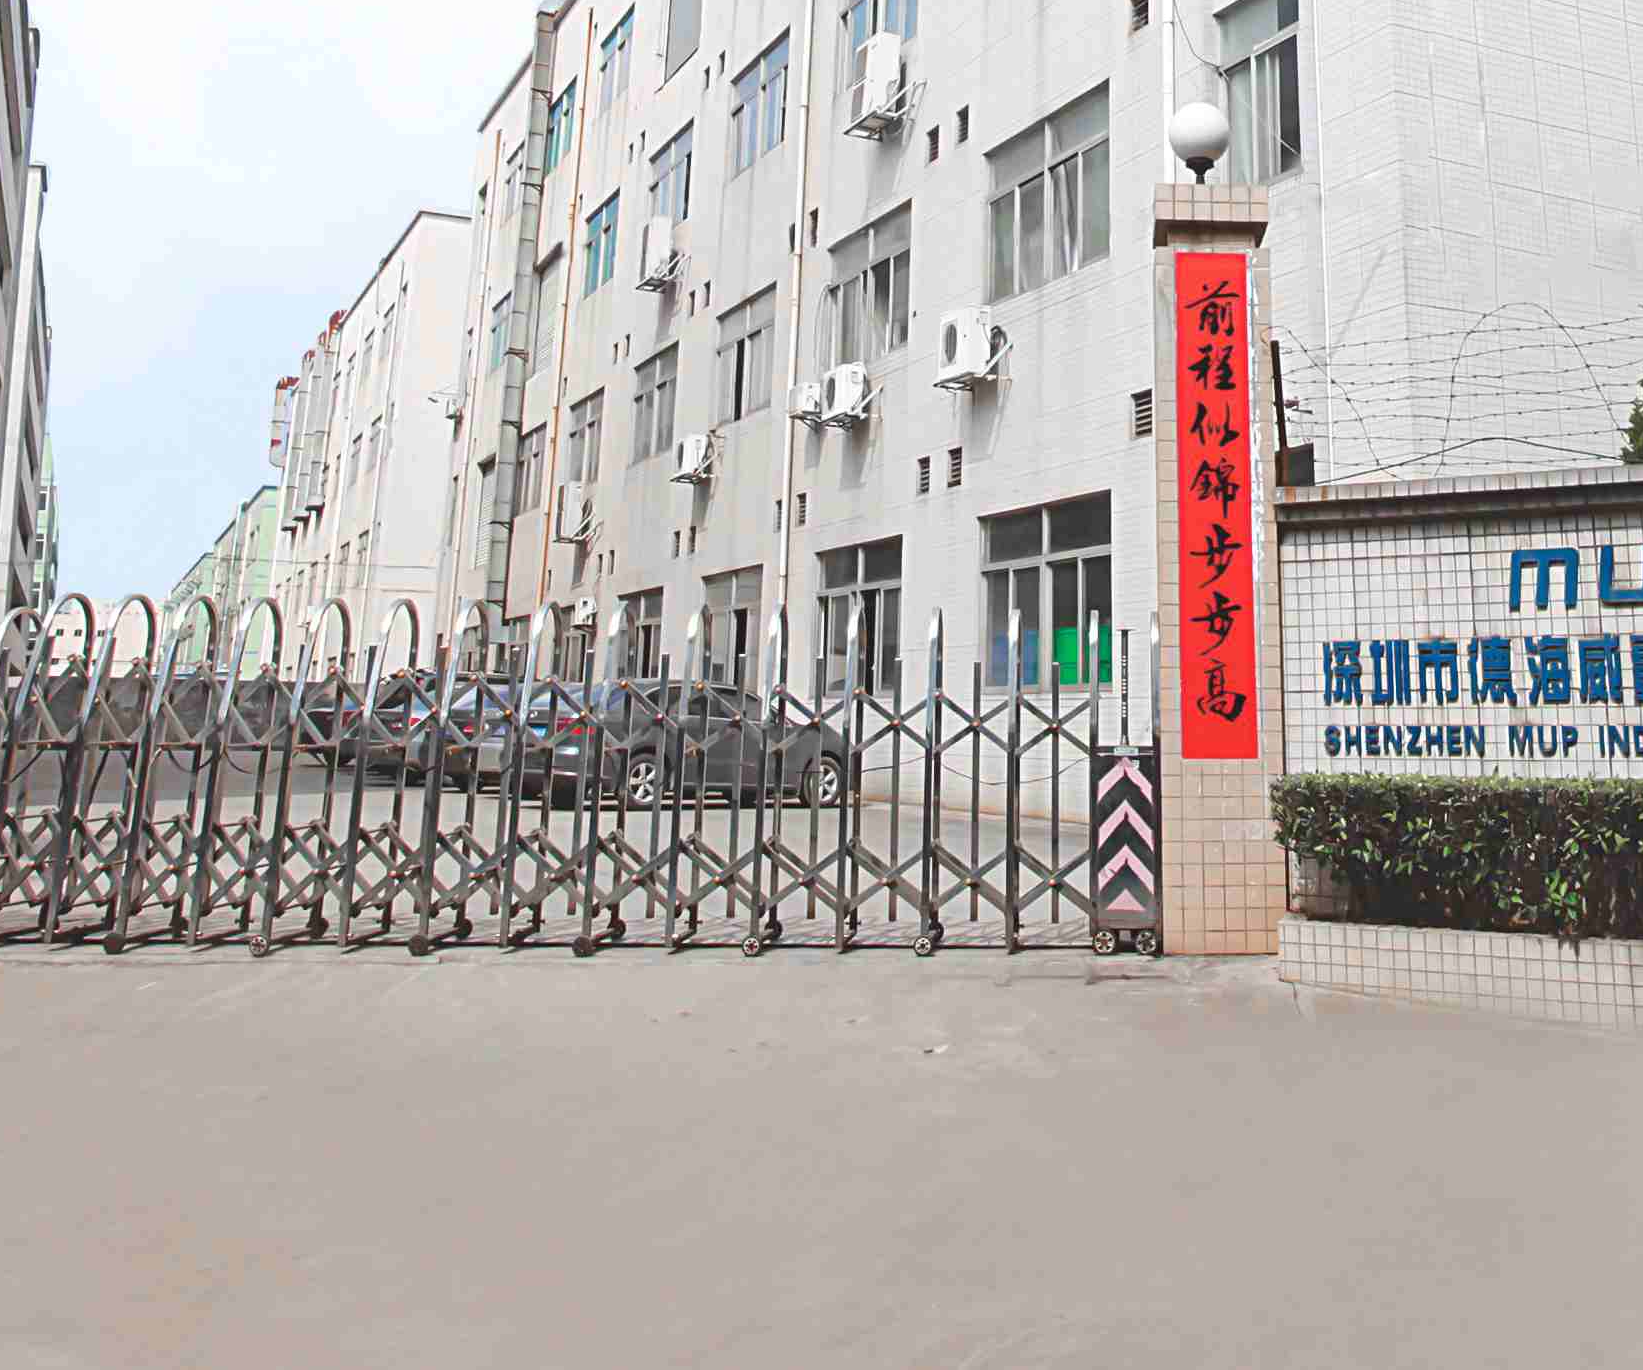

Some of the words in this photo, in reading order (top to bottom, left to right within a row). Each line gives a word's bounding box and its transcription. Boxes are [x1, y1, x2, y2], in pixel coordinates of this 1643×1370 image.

[1184, 280, 1247, 723] 前程似錦步步高
[1324, 724, 1485, 757] SHENZHEN
[1508, 724, 1579, 757] MUP
